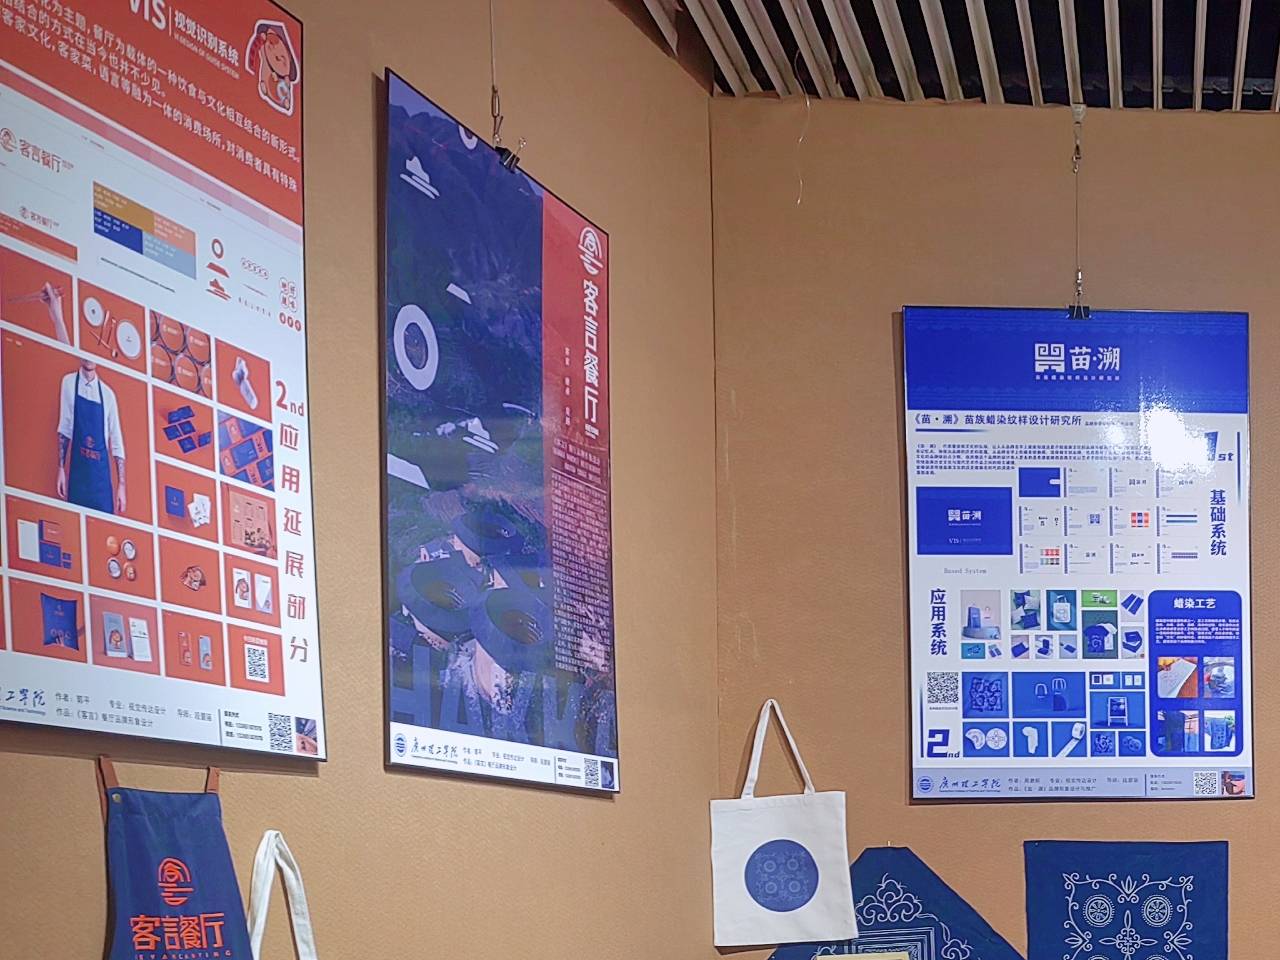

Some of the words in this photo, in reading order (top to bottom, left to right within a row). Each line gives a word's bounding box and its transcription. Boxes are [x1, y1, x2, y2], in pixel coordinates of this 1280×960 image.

[174, 11, 240, 66] 视觉识别系统
[964, 413, 1082, 427] 苗族蜡染纹样设计研究所
[279, 421, 308, 663] 应用延展部分
[1209, 489, 1227, 556] 基础系统
[930, 588, 947, 656] 应用系统
[1174, 597, 1217, 609] 蜡染工艺
[130, 912, 225, 951] 客言餐厅
